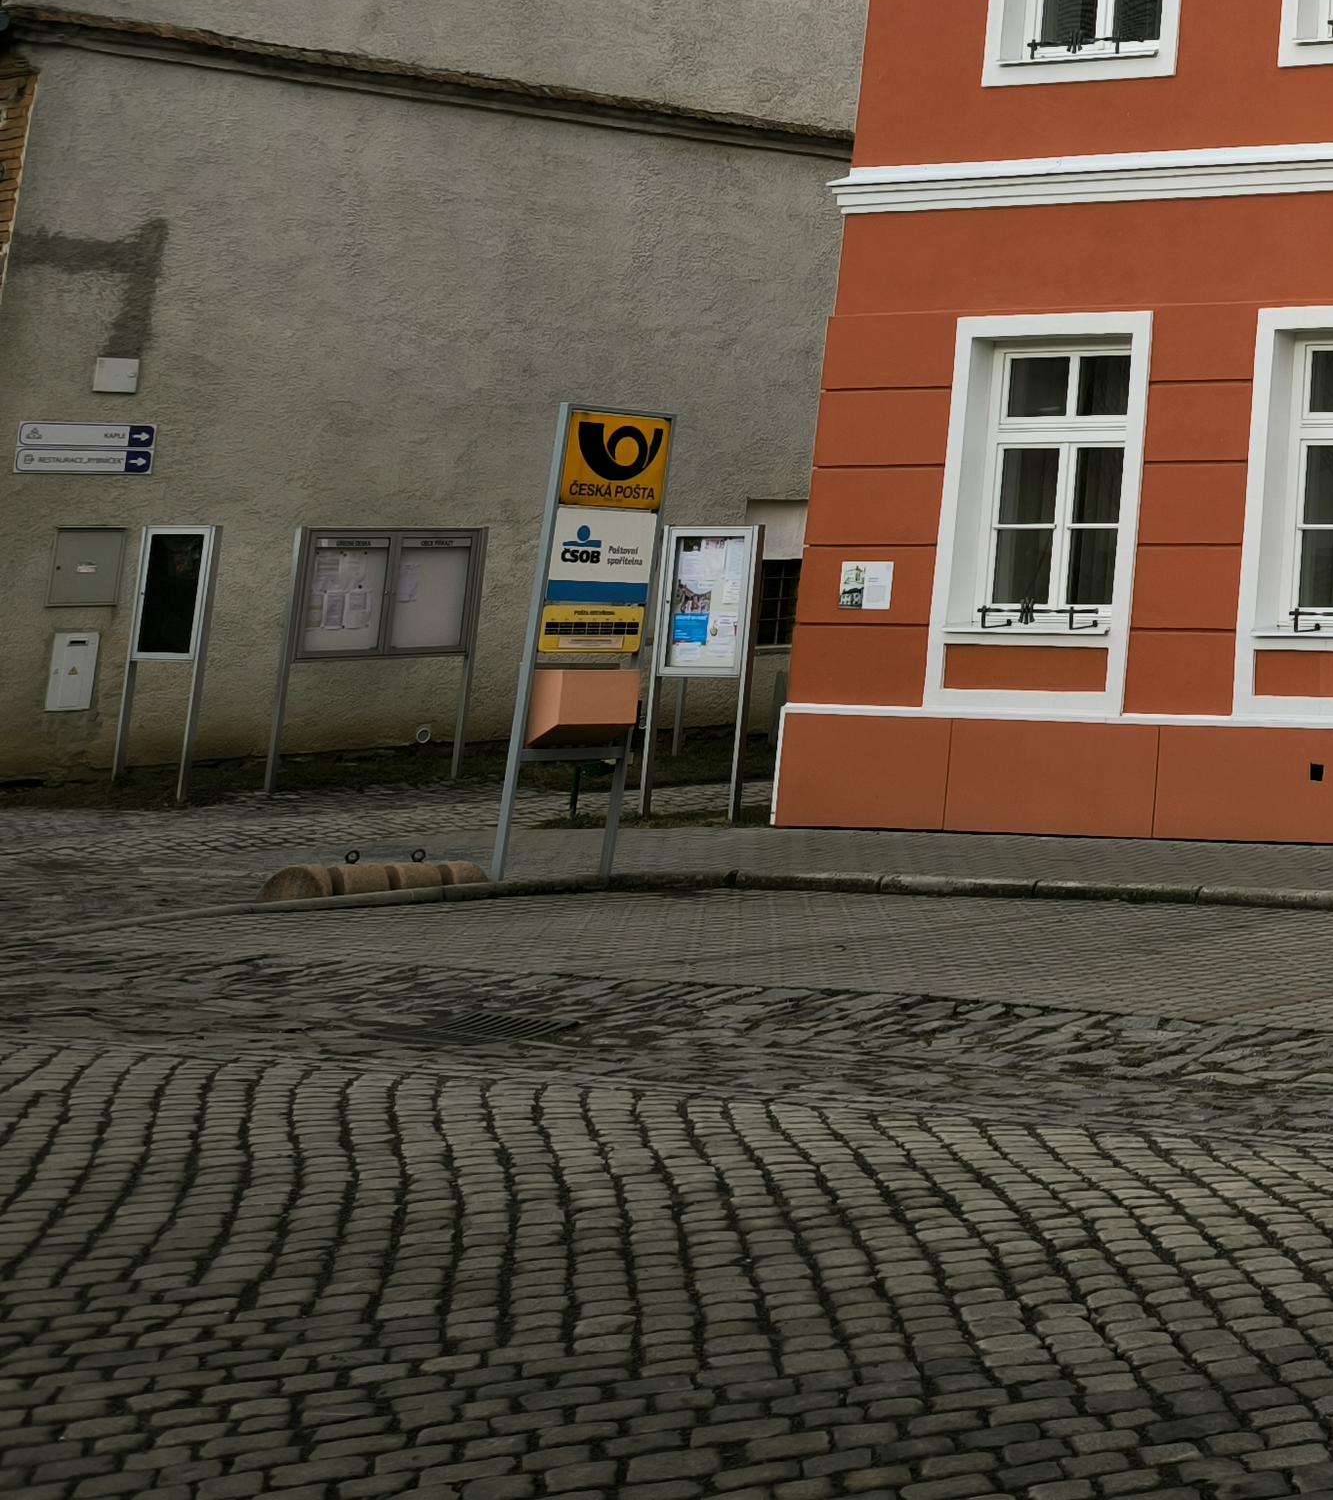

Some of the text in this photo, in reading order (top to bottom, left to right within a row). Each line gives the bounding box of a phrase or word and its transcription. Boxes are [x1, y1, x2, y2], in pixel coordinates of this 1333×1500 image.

[569, 480, 655, 500] ČESKÁ POŠTA
[561, 548, 601, 564] ČSOB
[608, 545, 639, 555] Poštovní
[607, 556, 643, 566] spořitelna
